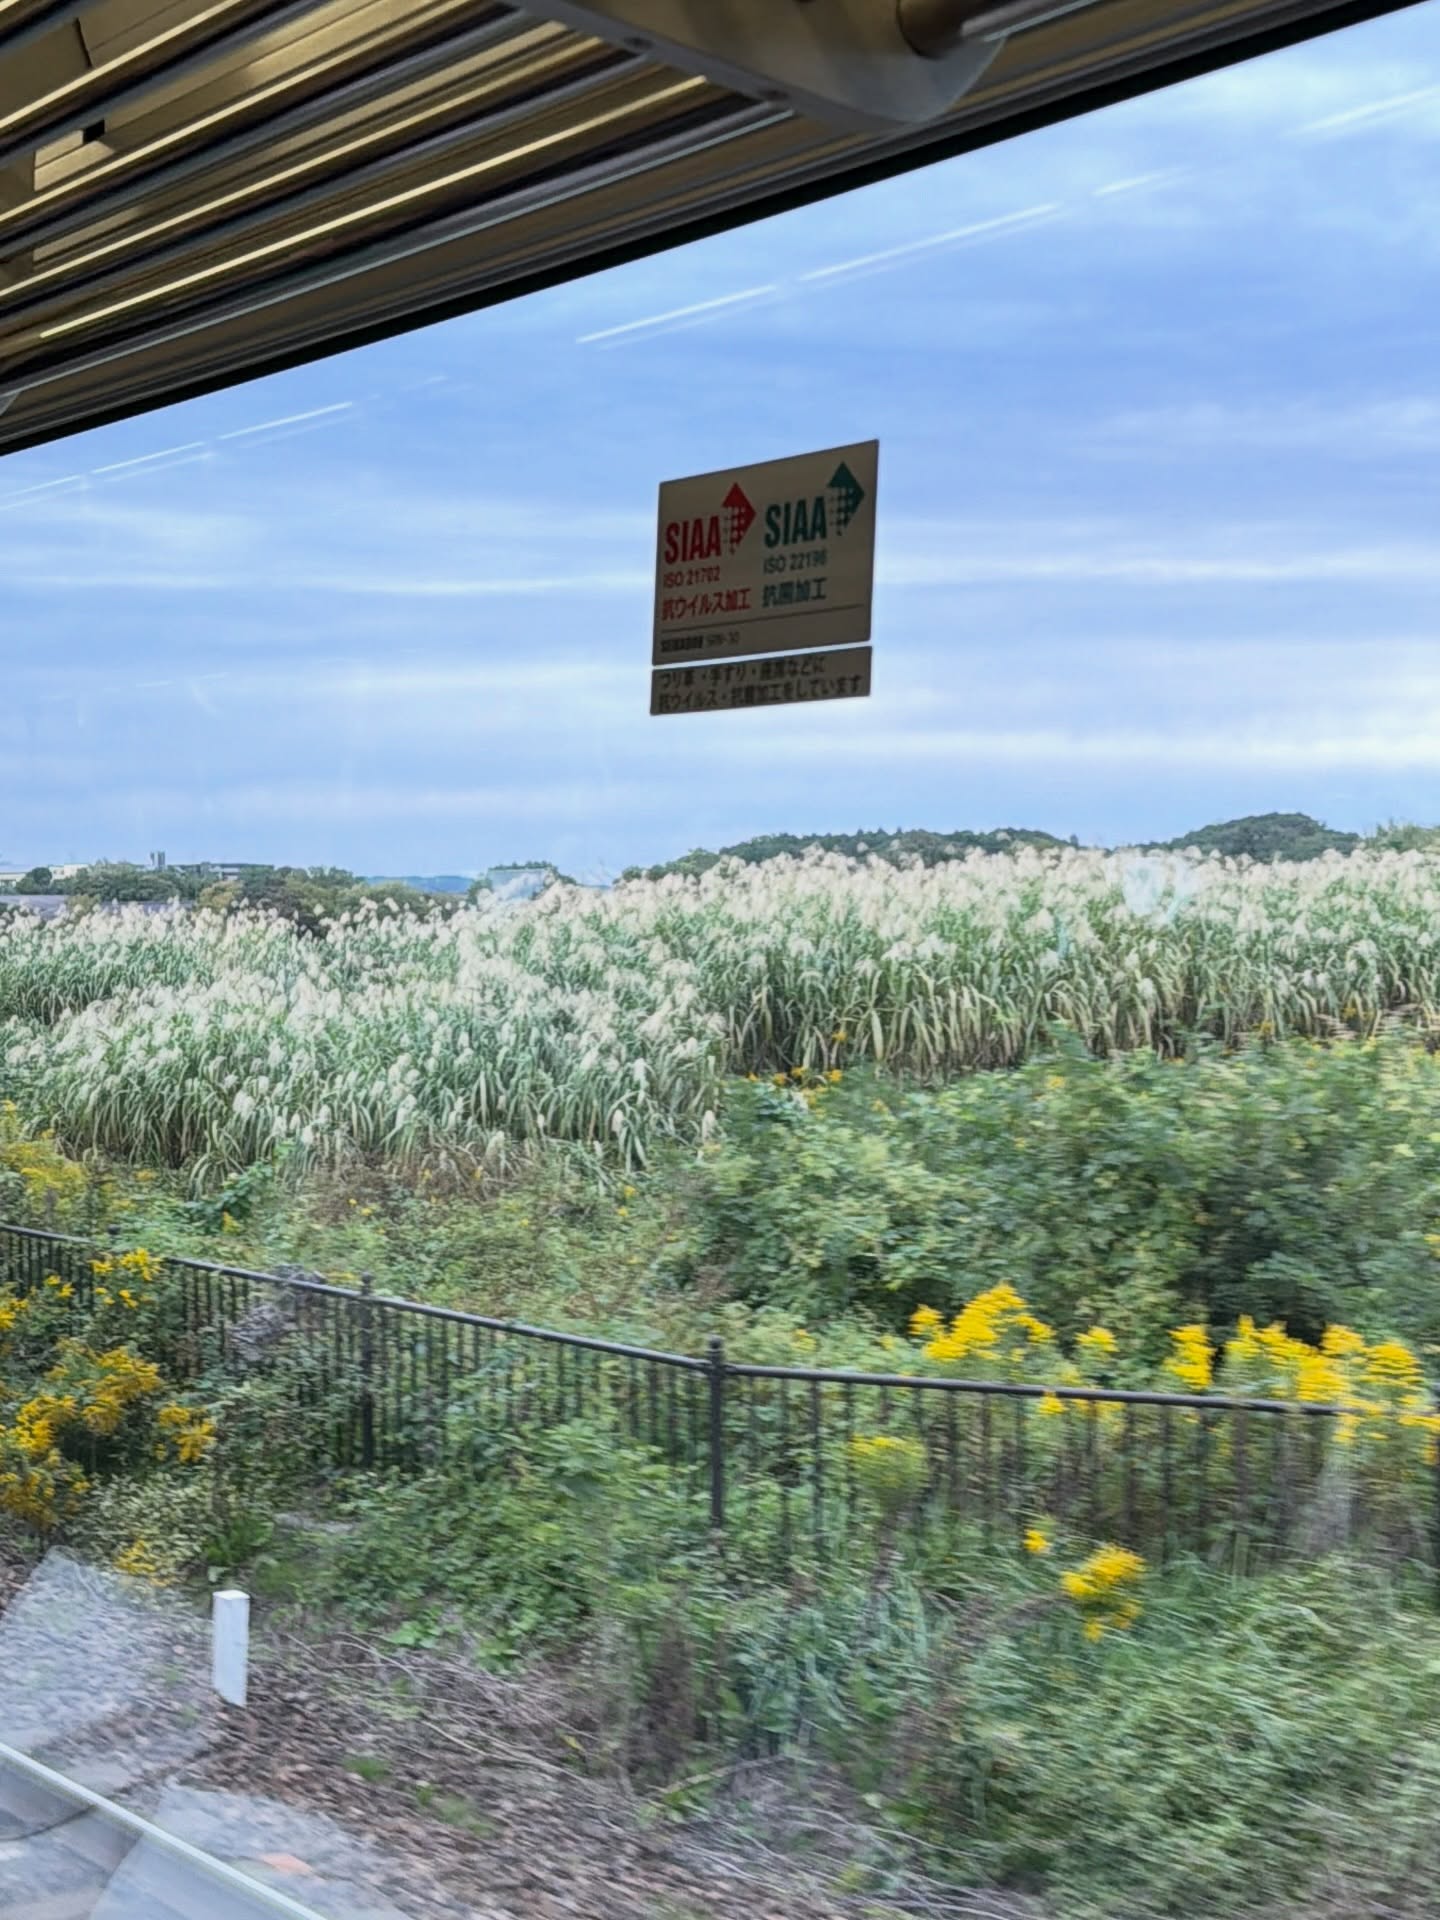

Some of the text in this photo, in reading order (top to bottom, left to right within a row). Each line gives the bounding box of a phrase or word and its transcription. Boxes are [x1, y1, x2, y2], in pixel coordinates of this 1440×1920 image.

[764, 496, 827, 548] SIAA
[664, 516, 721, 565] SIAA
[664, 566, 721, 588] ISO 21702
[764, 554, 786, 572] ISO
